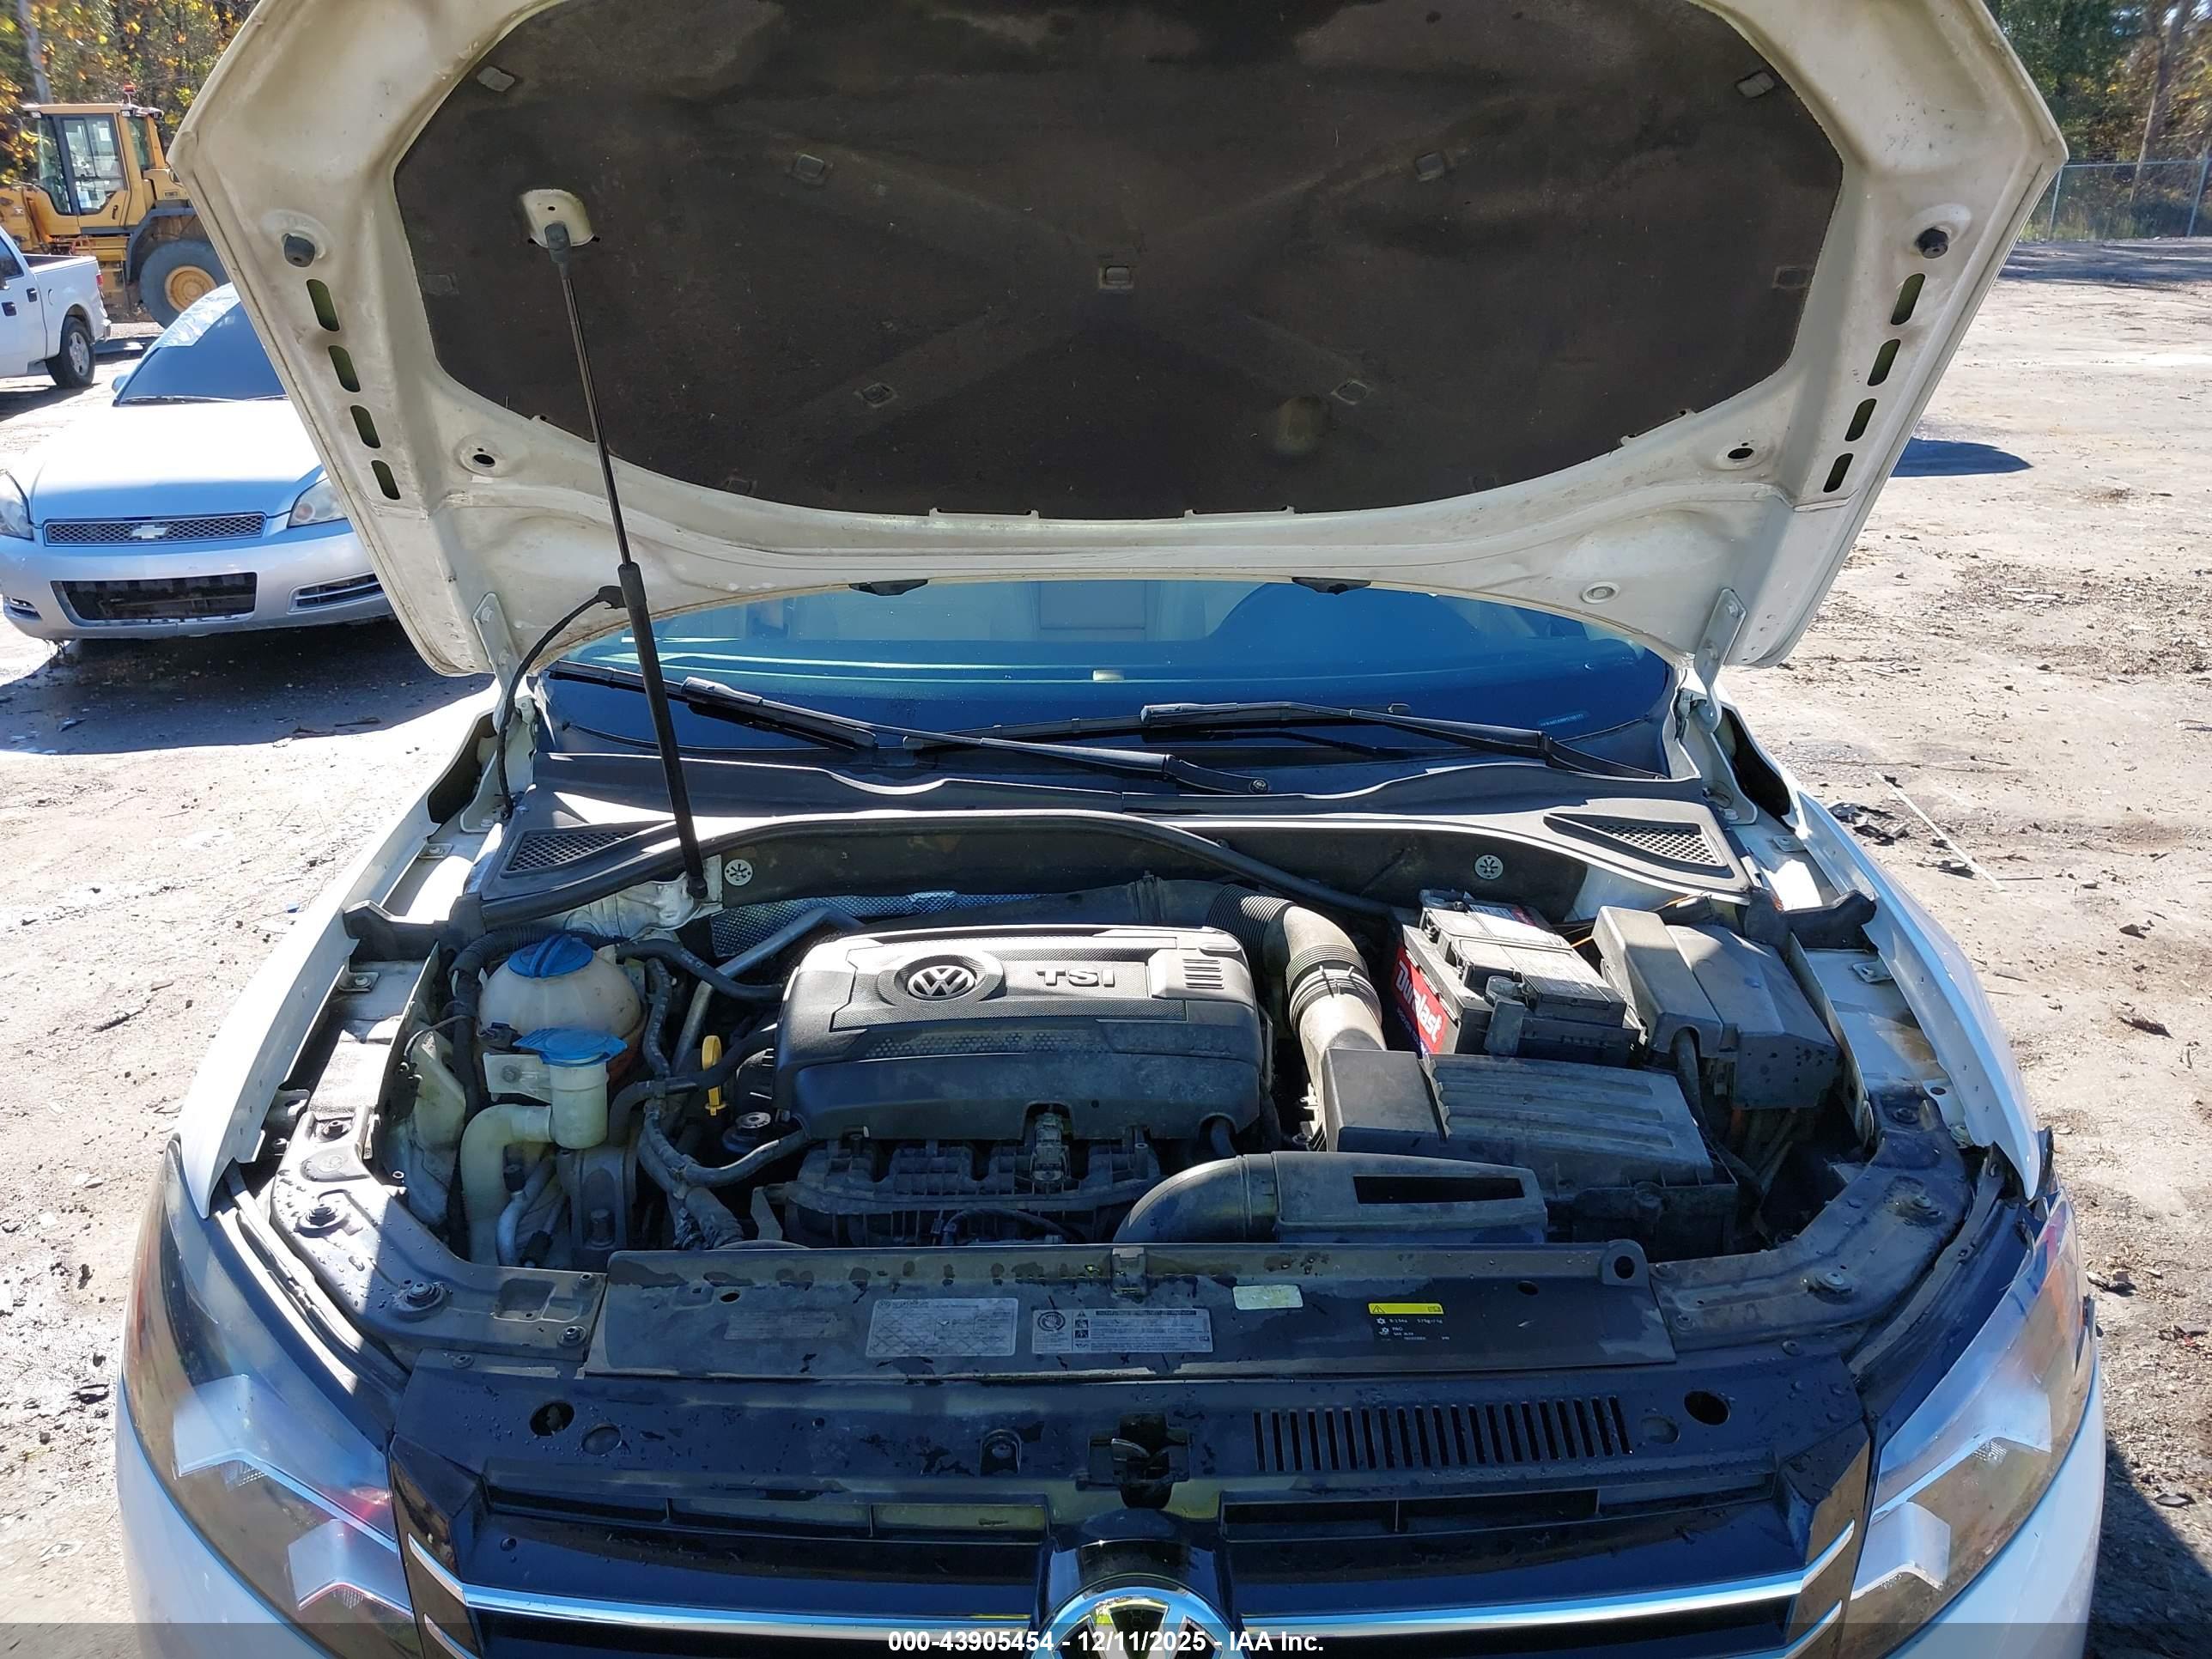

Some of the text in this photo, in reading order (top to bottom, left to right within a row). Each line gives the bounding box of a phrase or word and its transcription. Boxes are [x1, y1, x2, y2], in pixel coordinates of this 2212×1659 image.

[910, 966, 972, 998] VW
[1036, 969, 1115, 988] TSI
[1395, 959, 1443, 1044] Duralast
